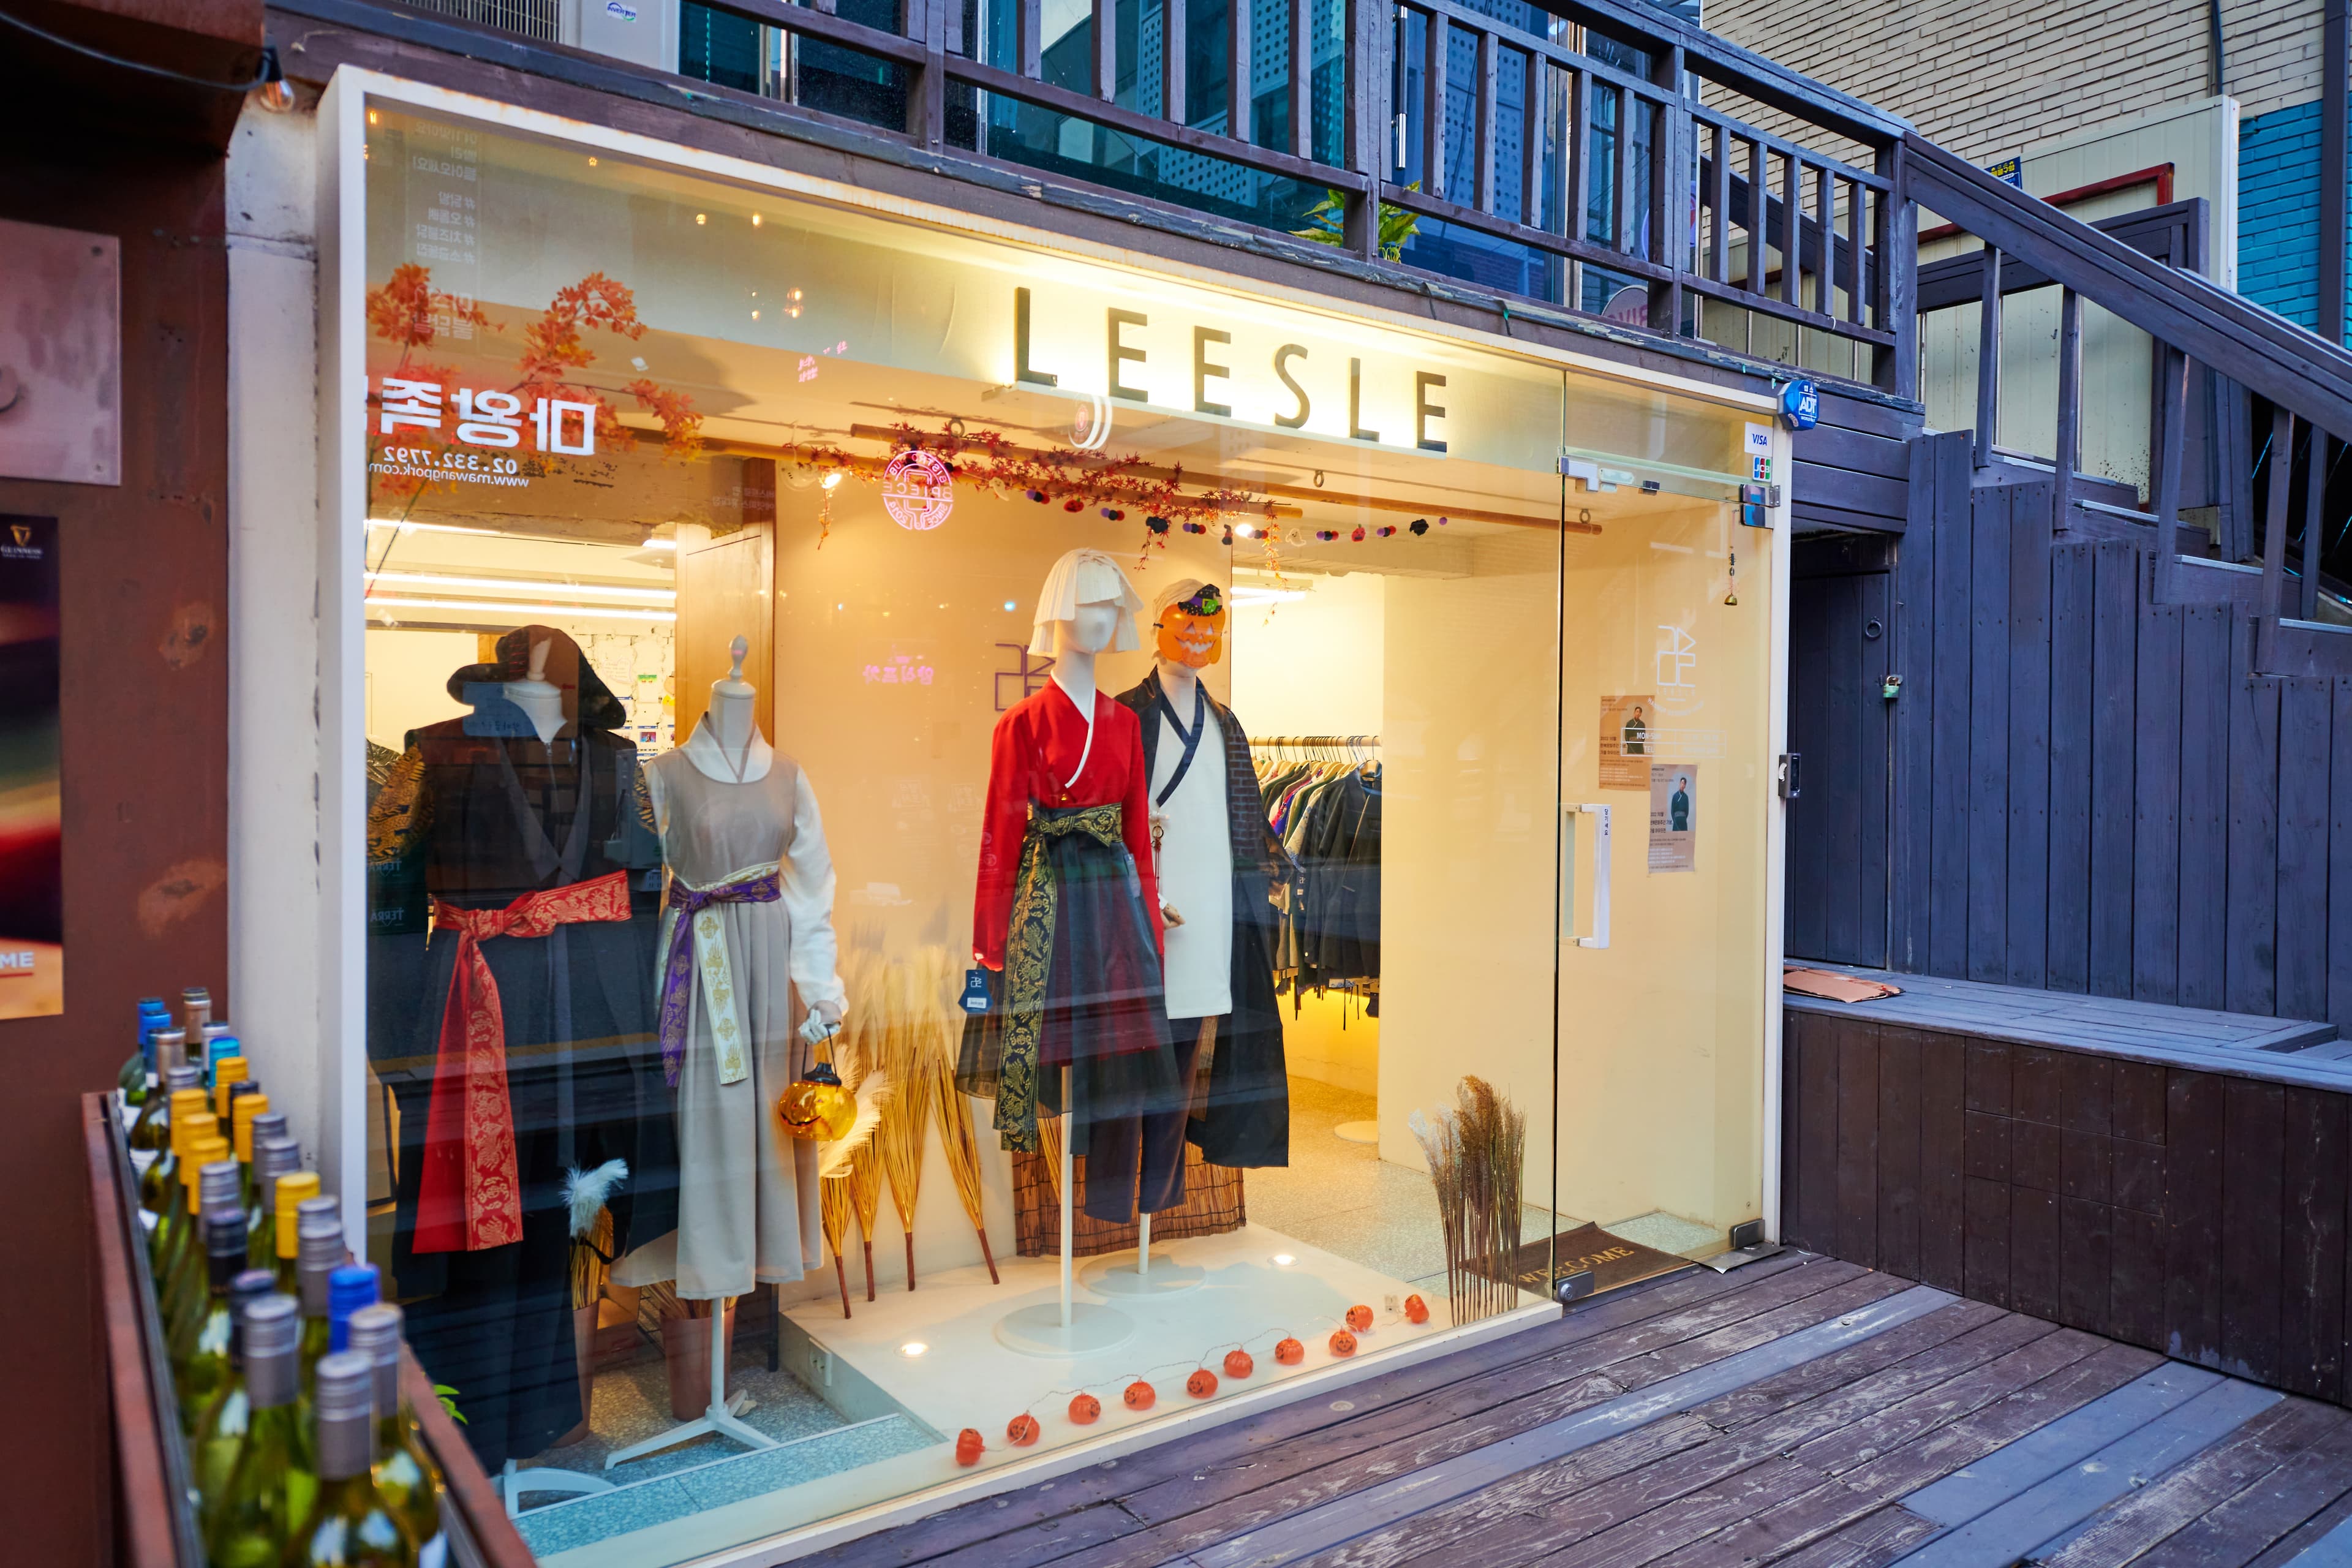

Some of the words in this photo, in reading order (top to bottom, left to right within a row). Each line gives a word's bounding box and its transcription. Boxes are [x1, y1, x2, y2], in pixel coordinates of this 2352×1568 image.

[1014, 286, 1447, 453] LEESLE
[1799, 396, 1817, 414] ADT
[1752, 434, 1767, 446] VISA
